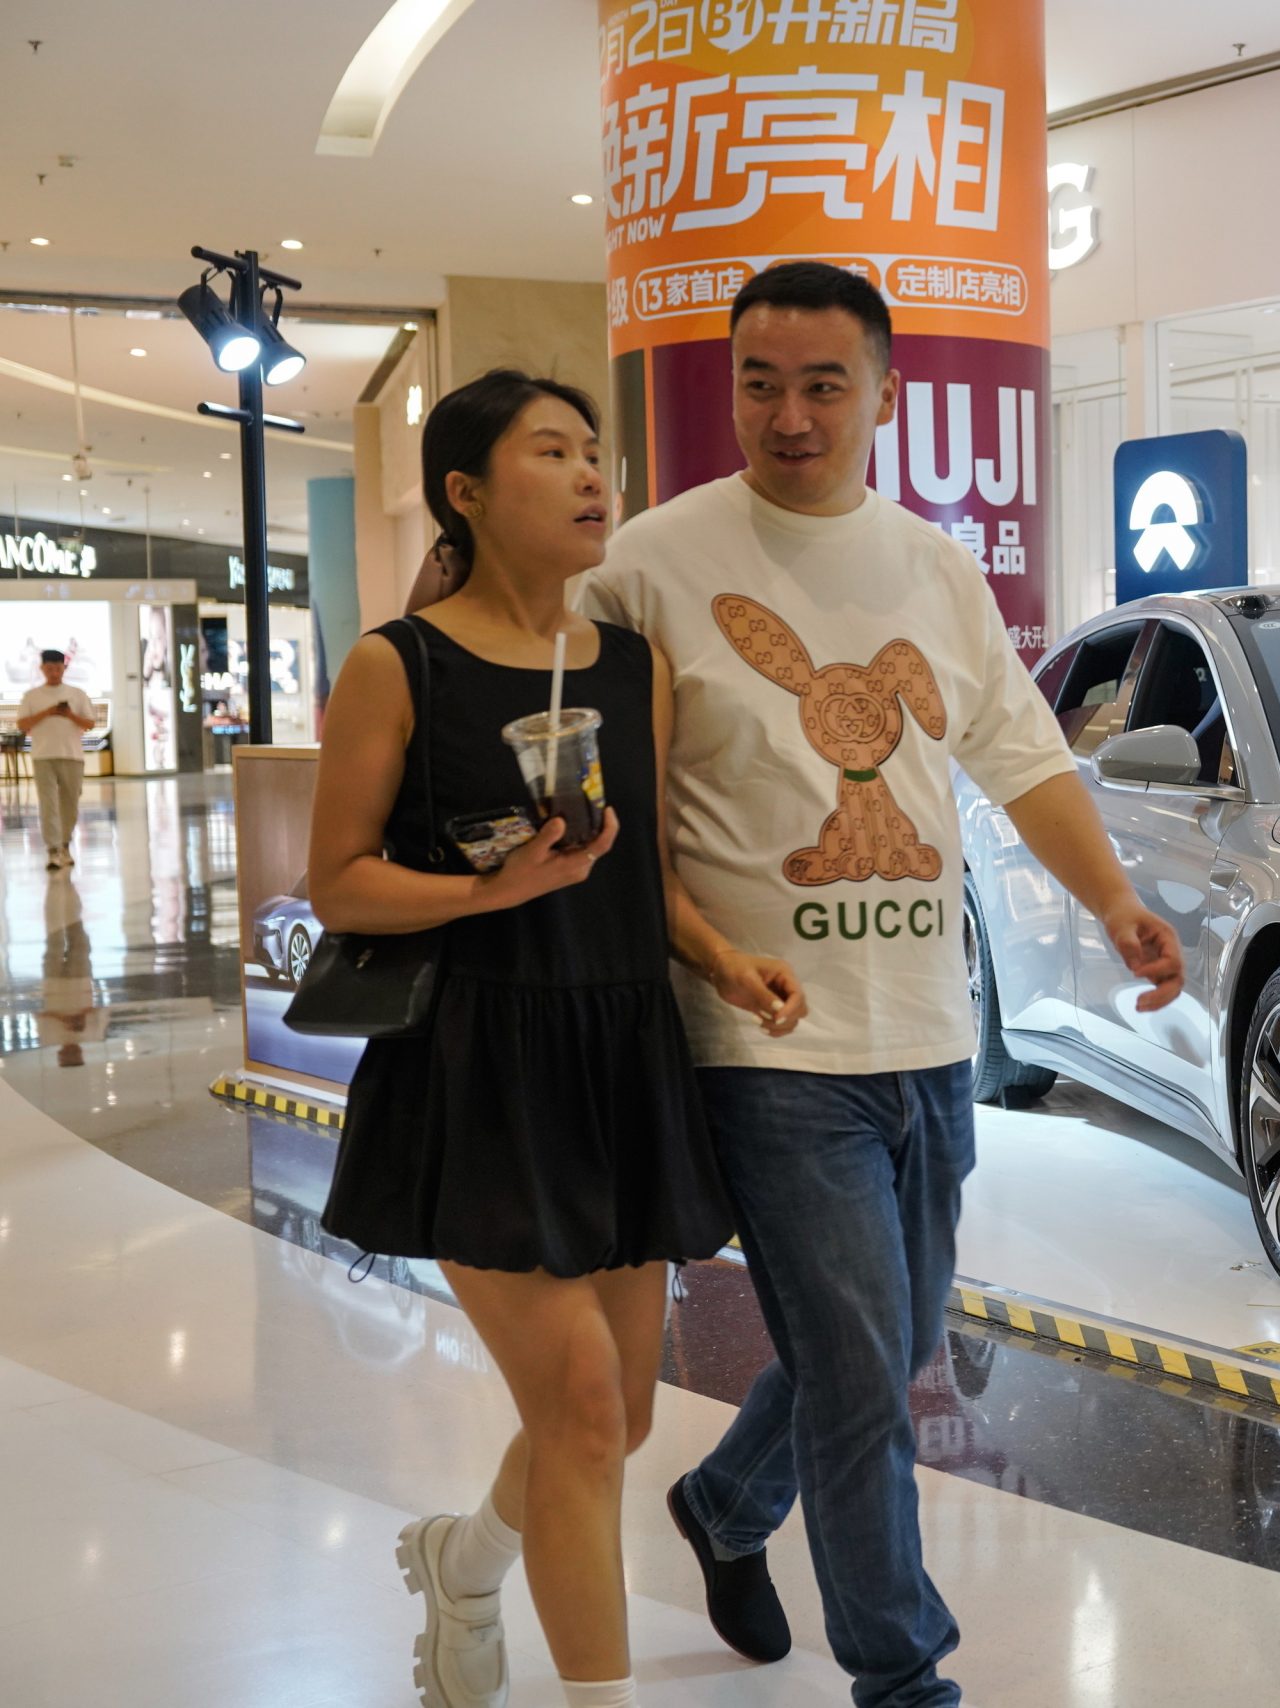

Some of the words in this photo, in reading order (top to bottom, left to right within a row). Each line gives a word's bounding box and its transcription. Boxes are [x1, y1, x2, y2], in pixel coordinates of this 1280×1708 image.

[626, 212, 666, 245] NOW
[638, 266, 746, 313] 13家首店
[897, 264, 1021, 307] 定制店亮相
[932, 515, 1026, 575] 良品
[793, 898, 944, 941] GUCCI
